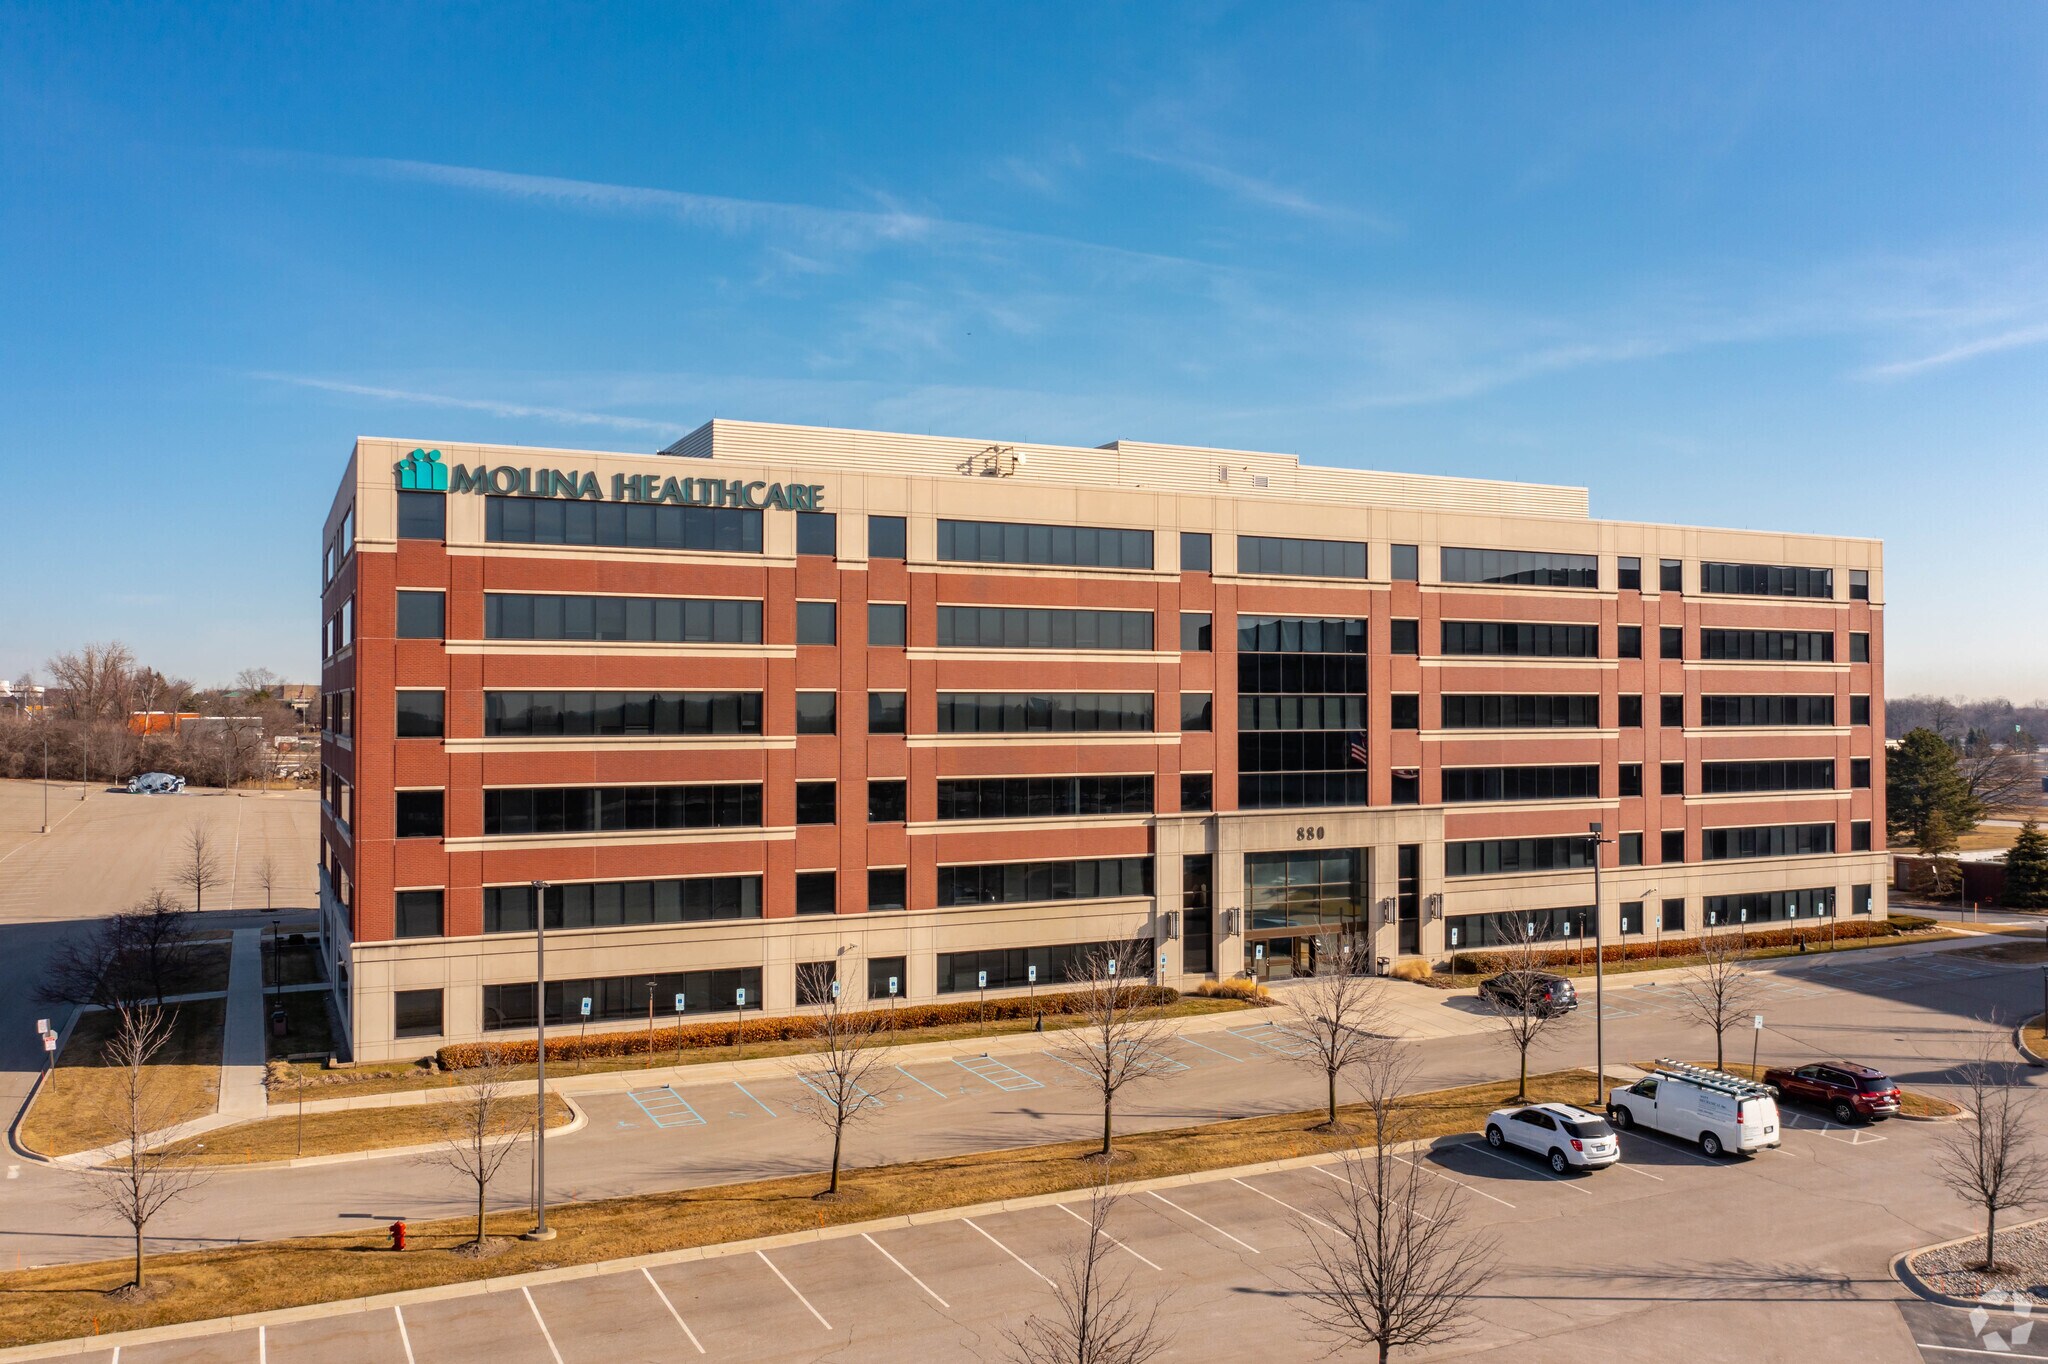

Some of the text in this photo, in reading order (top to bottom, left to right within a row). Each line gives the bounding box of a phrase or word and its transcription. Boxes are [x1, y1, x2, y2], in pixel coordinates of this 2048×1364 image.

[449, 463, 825, 511] MOLINA HEALTHCARE
[1296, 826, 1325, 841] 880
